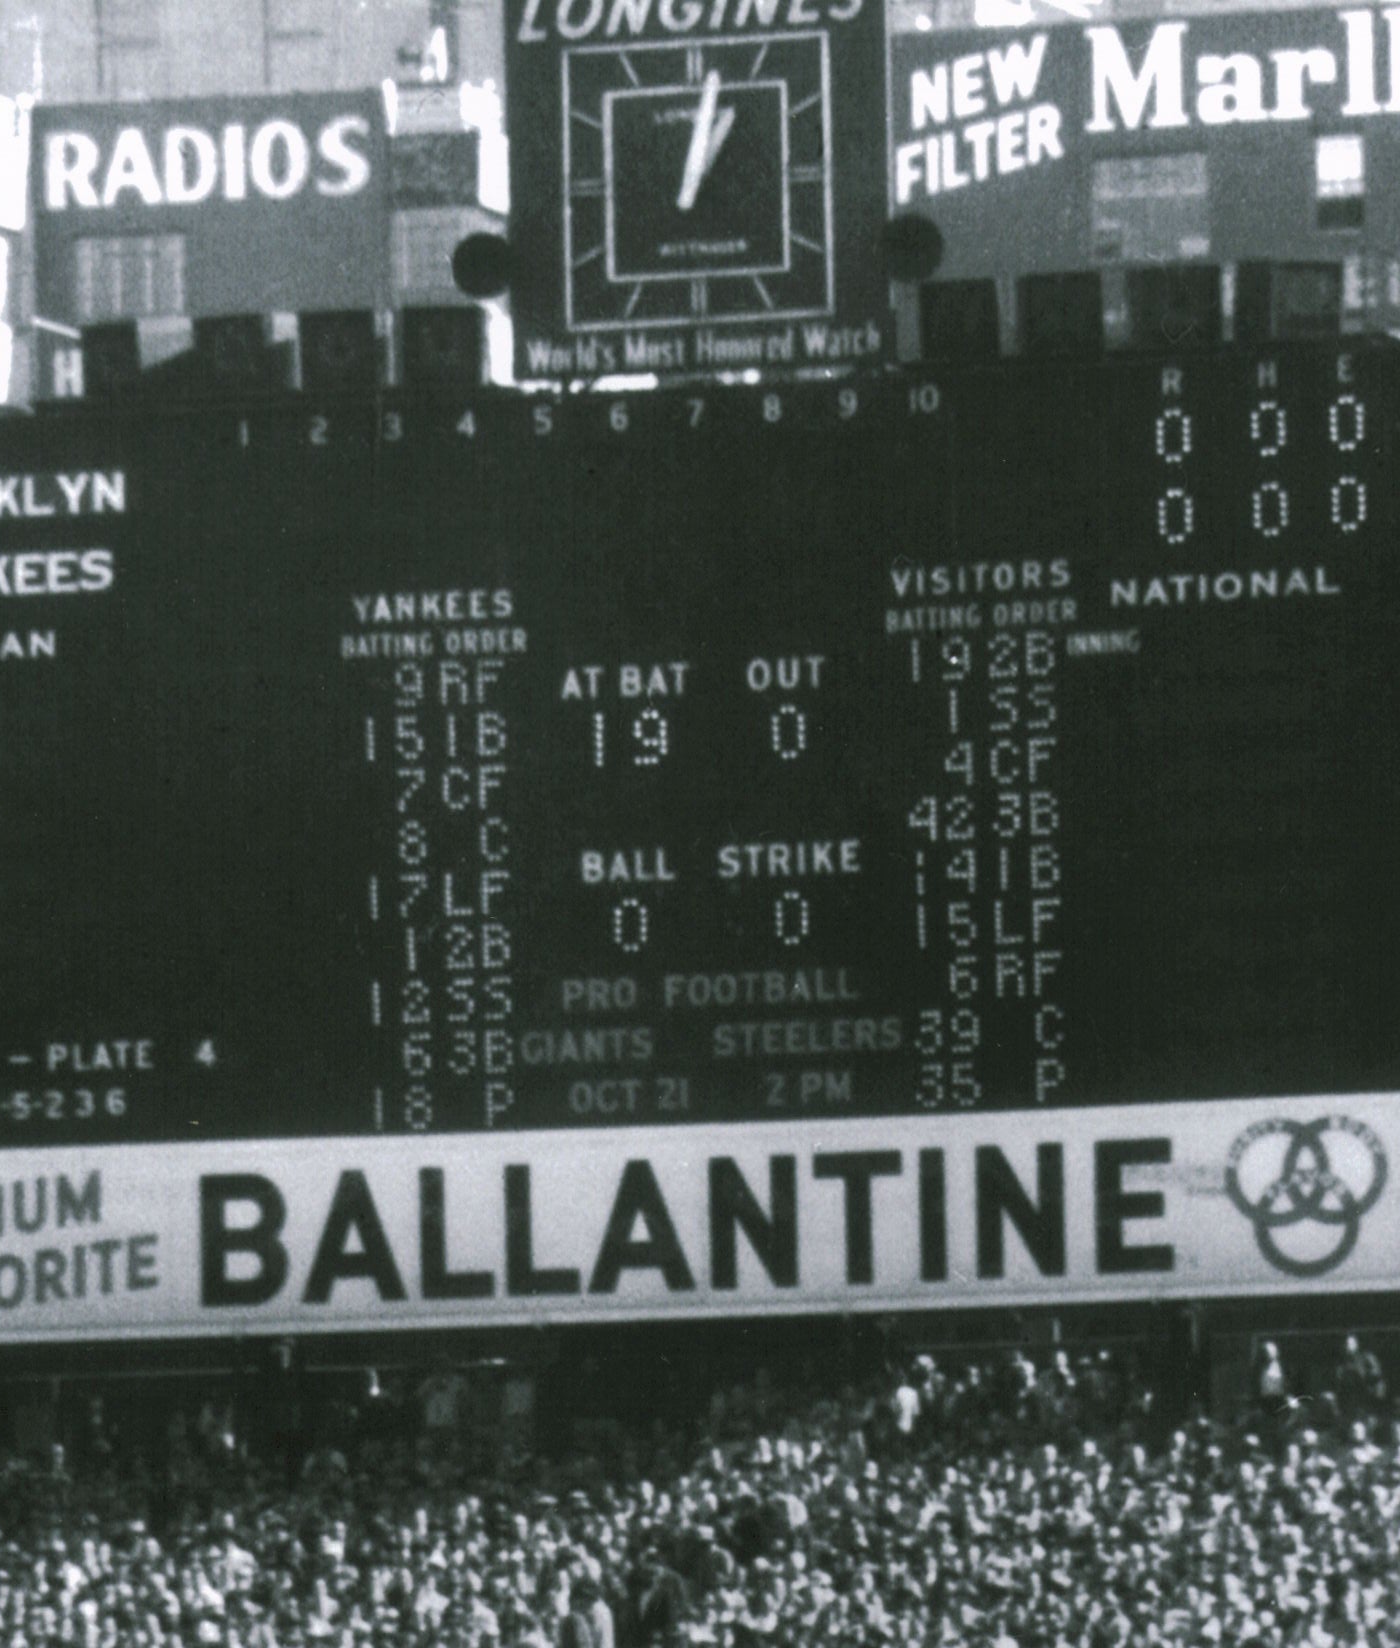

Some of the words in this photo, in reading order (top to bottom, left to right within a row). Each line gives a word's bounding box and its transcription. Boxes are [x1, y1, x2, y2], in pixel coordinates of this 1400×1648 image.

[910, 34, 1046, 129] NEW
[45, 116, 371, 210] RADIOS
[896, 104, 1063, 203] FILTER
[526, 336, 616, 374] World's
[625, 332, 685, 366] Most
[803, 321, 880, 358] Watch
[1164, 367, 1181, 395] R
[1260, 364, 1277, 389] H
[1339, 356, 1353, 383] E
[310, 417, 328, 444] 2
[385, 414, 402, 441] 3
[457, 409, 475, 436] 4
[533, 406, 551, 435] 5
[609, 403, 629, 432] 6
[689, 400, 704, 427] 7
[762, 393, 783, 422] 8
[839, 389, 858, 419] 9
[909, 386, 939, 413] 10
[1157, 408, 1193, 463] 0
[1329, 395, 1366, 451] 0
[1158, 488, 1194, 543] 0
[1253, 482, 1289, 537] 0
[1331, 476, 1367, 531] 0
[891, 559, 1072, 597] VISITORS
[1110, 568, 1340, 606] NATIONAL
[353, 589, 513, 622] YANKEES
[886, 603, 981, 634] BATTING
[993, 598, 1078, 627] ORDER
[341, 631, 434, 659] BATTING
[445, 627, 528, 655] ORDER
[440, 660, 505, 706] RF
[561, 665, 604, 701] AT
[618, 661, 690, 698] BAT
[746, 656, 827, 690] OUT
[593, 709, 668, 767] 19
[771, 704, 807, 759] 0
[580, 849, 676, 883] BALL
[718, 839, 861, 878] STRIKE
[614, 898, 648, 953] 0
[775, 891, 809, 946] 0
[562, 978, 637, 1011] PRO
[663, 967, 857, 1007] FOOTBALL
[48, 1039, 155, 1071] PLATE
[196, 1038, 217, 1068] 4
[519, 1027, 653, 1064] GIANTS
[713, 1017, 900, 1056] STEELERS
[568, 1079, 642, 1113] OCT
[800, 1070, 852, 1104] PM
[200, 1137, 1175, 1308] BALLANTINE
